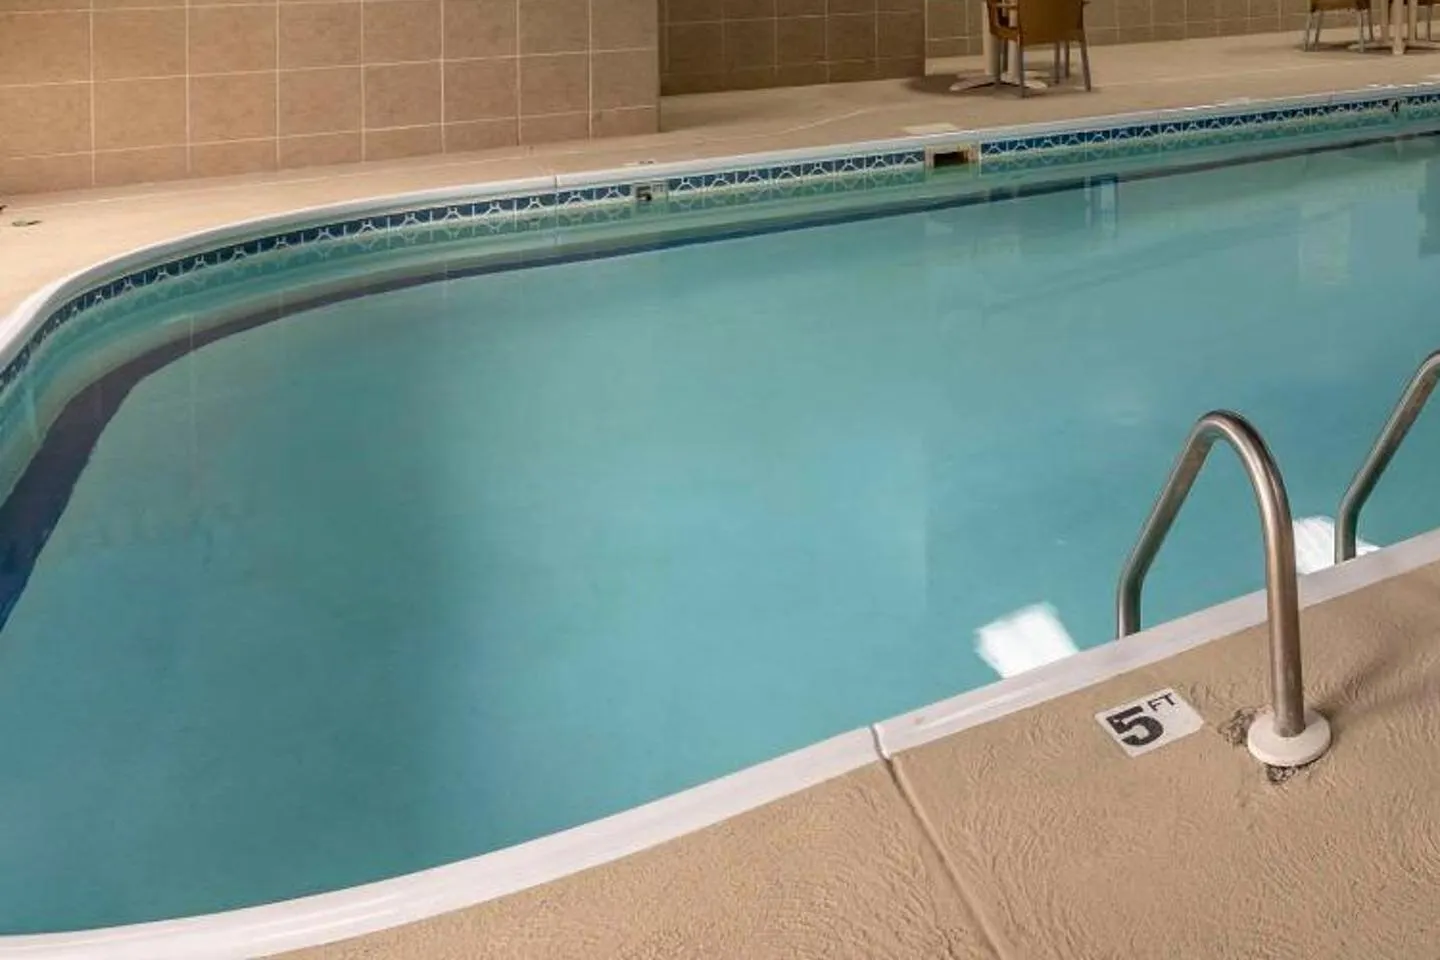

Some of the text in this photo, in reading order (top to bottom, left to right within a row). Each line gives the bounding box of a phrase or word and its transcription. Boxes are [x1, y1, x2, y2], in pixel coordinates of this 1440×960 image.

[636, 186, 652, 202] 5
[1106, 692, 1175, 746] 5 FT
